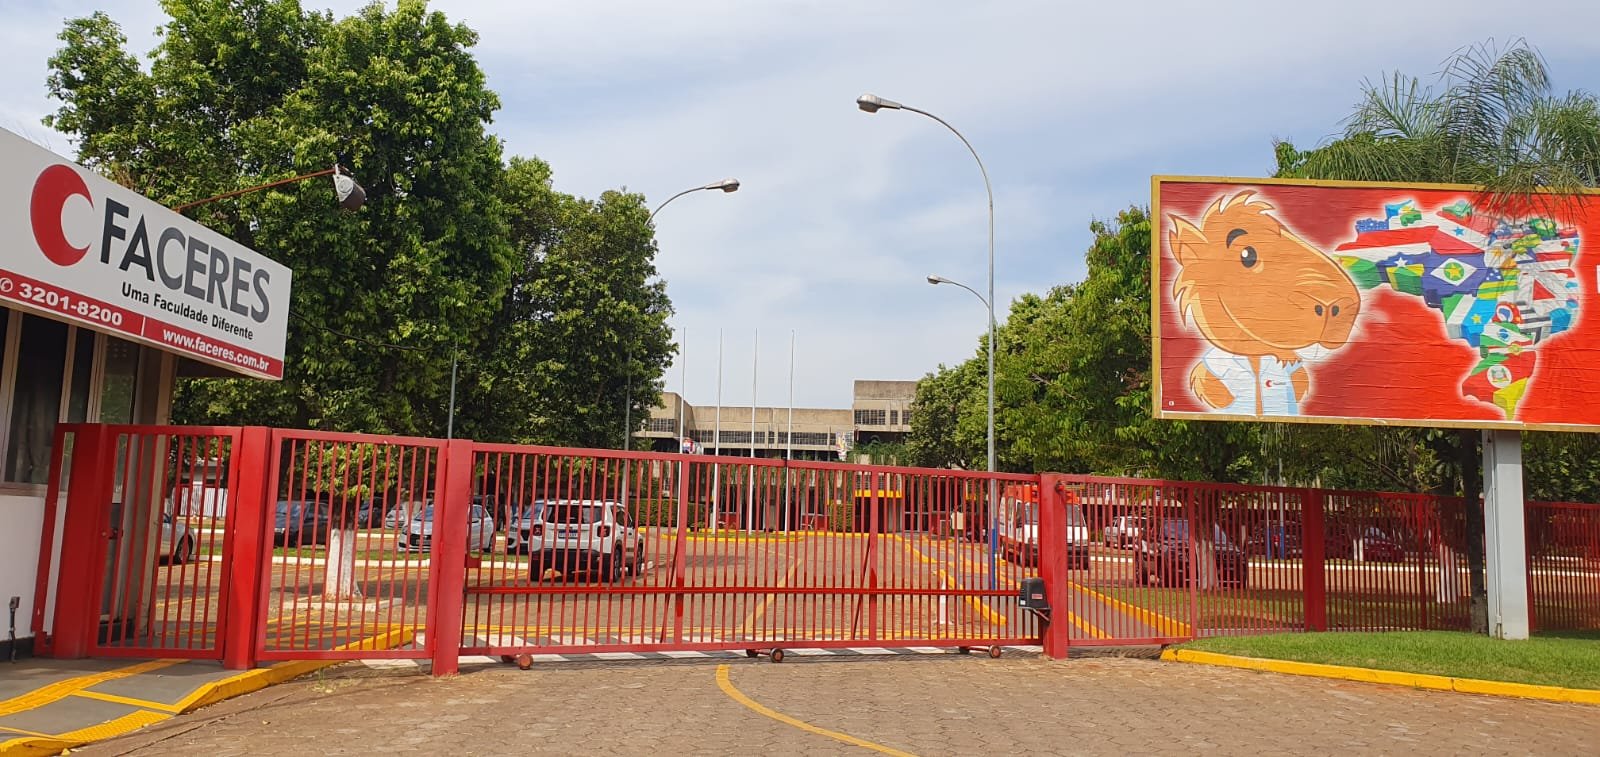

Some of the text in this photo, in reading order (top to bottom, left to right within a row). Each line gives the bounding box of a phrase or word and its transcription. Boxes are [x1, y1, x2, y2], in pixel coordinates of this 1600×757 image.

[100, 197, 271, 323] FACERES
[18, 283, 123, 327] 3201-8200
[122, 281, 254, 340] Uma Faculdade Diferente
[162, 329, 269, 371] www.faceres.com.br
